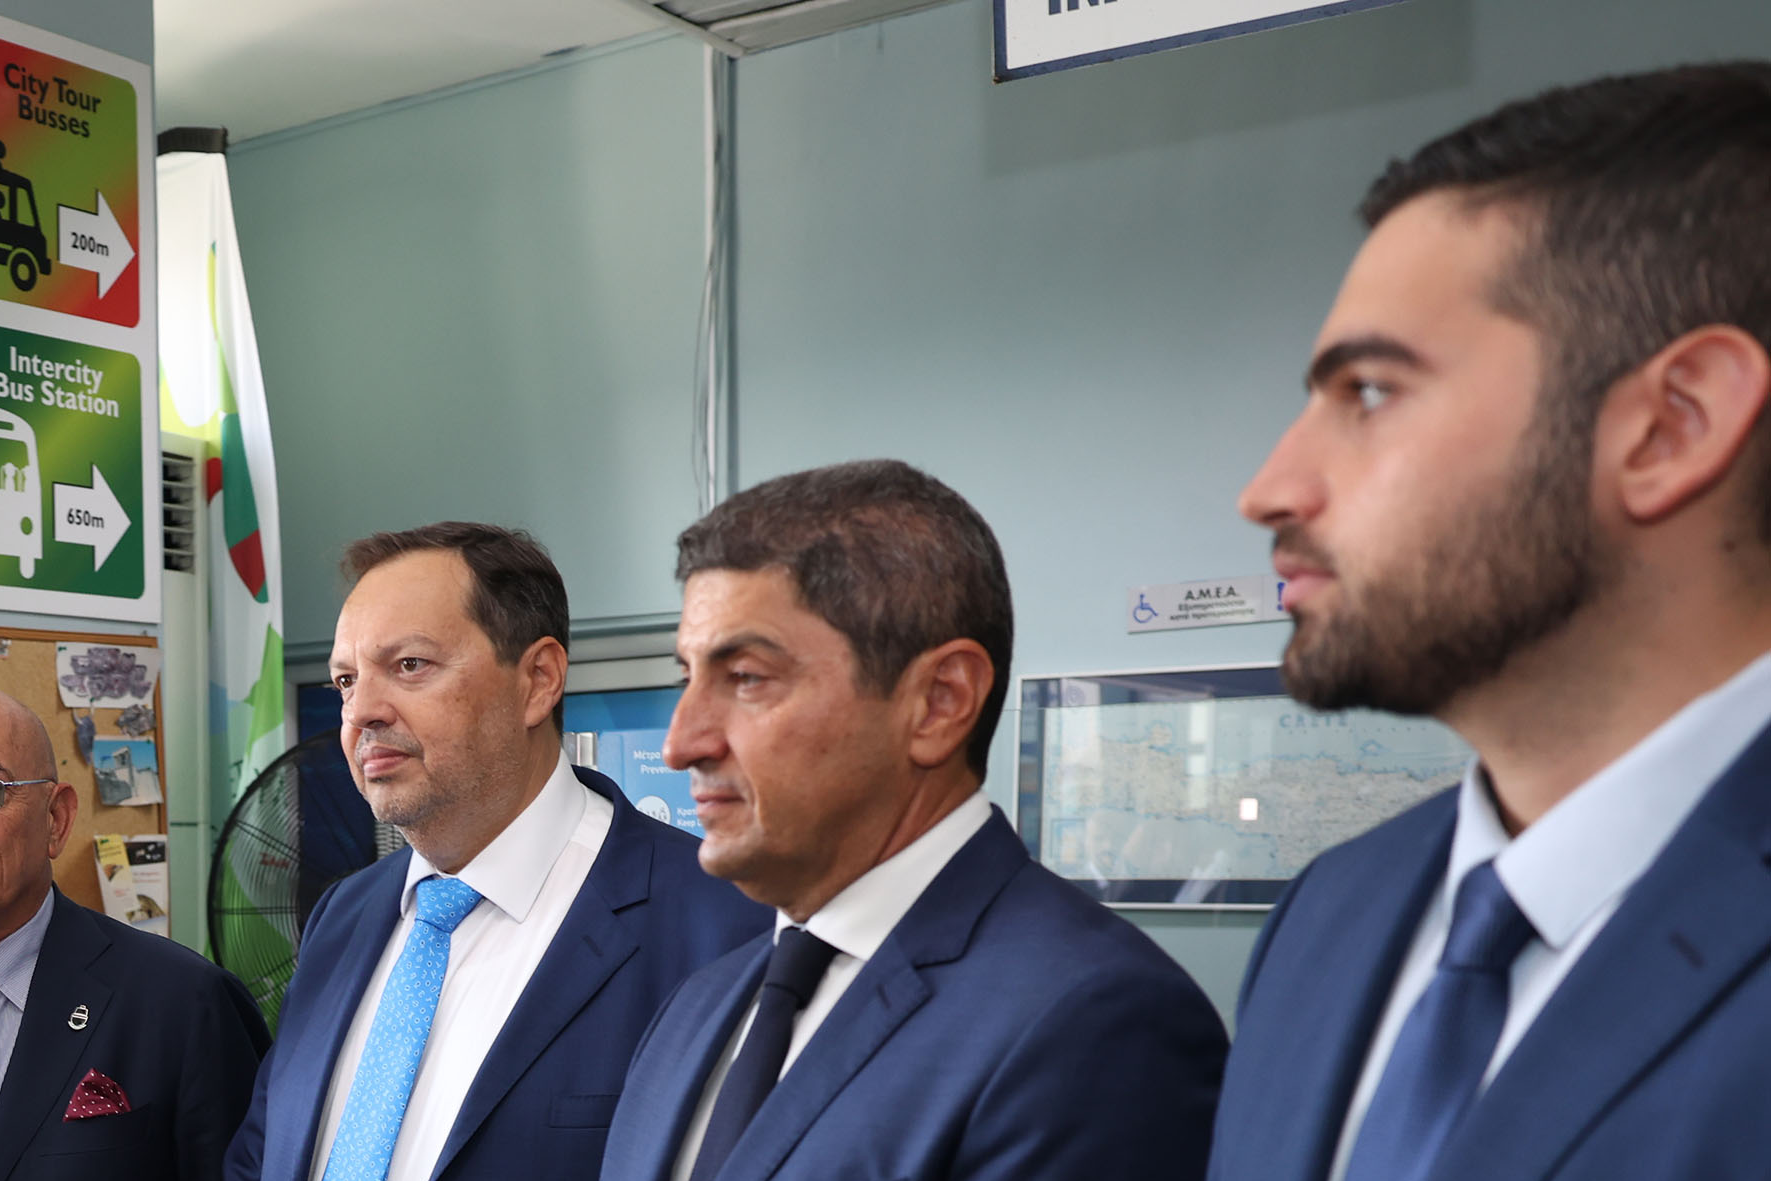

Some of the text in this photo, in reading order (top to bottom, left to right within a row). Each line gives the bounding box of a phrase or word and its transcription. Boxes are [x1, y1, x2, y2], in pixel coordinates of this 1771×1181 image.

[4, 63, 101, 113] City Tour
[18, 93, 90, 138] Busses
[71, 232, 109, 256] 200m
[9, 346, 103, 394] Intercity
[41, 380, 120, 418] Station
[66, 508, 105, 528] 650m
